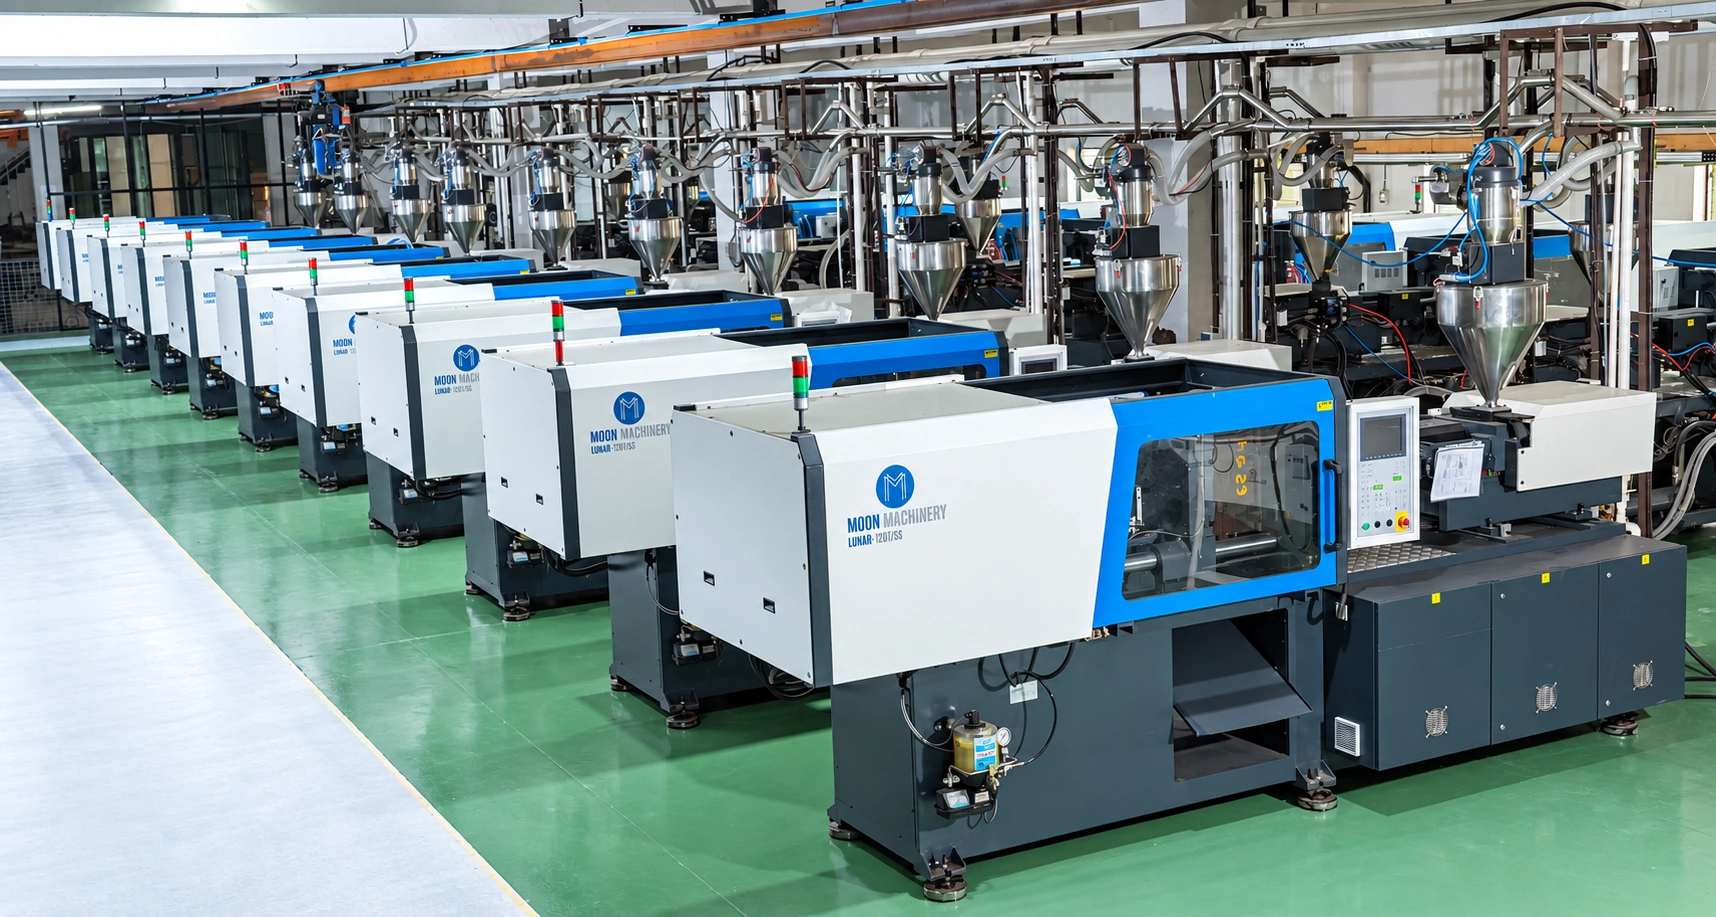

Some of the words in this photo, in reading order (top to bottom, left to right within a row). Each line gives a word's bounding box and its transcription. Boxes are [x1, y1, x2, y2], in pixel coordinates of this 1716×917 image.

[434, 374, 457, 386] MOON
[590, 428, 618, 444] MOON
[620, 423, 671, 441] MACHINERY
[847, 513, 881, 534] MOON
[883, 503, 948, 529] MACHINERY
